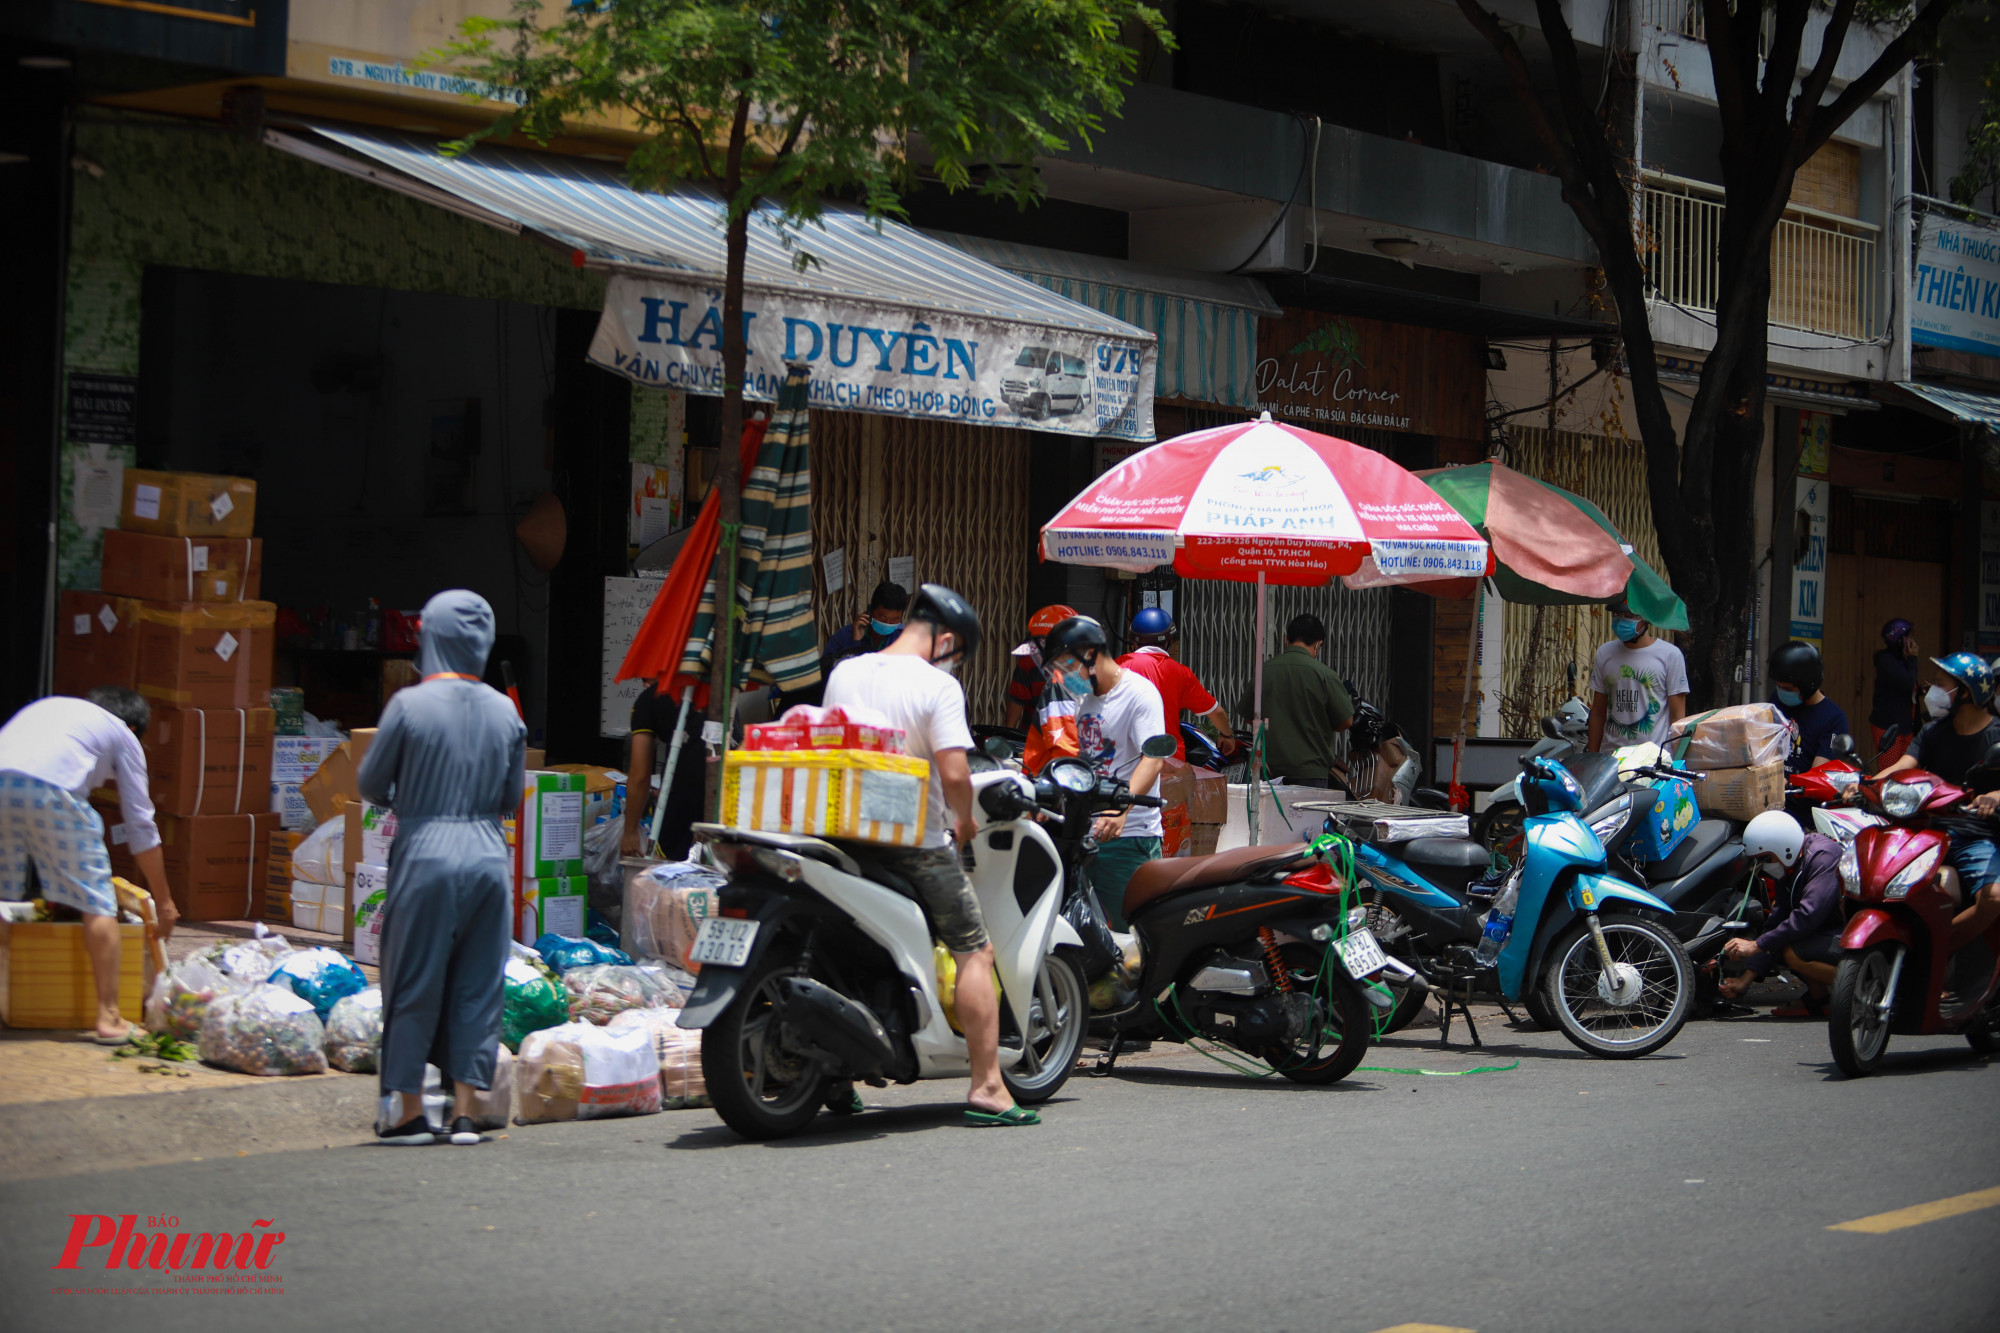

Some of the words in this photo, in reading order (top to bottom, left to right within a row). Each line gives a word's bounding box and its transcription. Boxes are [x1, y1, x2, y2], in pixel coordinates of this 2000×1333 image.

[413, 73, 435, 89] DUY
[1937, 229, 1960, 253] NHÀ
[1961, 237, 1997, 263] THUỐC
[1917, 264, 1980, 314] THIÊN
[780, 316, 979, 382] DUYÊN
[1096, 344, 1141, 375] 97B
[1255, 357, 1327, 396] Dalat
[1332, 368, 1401, 404] Corner
[866, 384, 905, 409] THEO
[949, 388, 997, 418] ĐỒNG
[1206, 511, 1275, 528] PHÁP
[1281, 515, 1335, 530] ANH
[1197, 537, 1250, 546] 222-224-226
[1286, 538, 1304, 548] Duy
[1058, 545, 1104, 558] HOTLINE:
[1106, 546, 1167, 559] 0906.843.118
[1238, 547, 1261, 557] Quận
[1262, 548, 1276, 558] 10,
[1277, 548, 1311, 557] TP.HCM
[1247, 558, 1263, 566] sau
[1264, 558, 1286, 567] TTYK
[1288, 559, 1305, 568] Hòa
[1306, 558, 1328, 570] Hảo)
[1380, 556, 1421, 568] HOTLINE:
[1423, 557, 1482, 571] 0906.843.118
[1799, 579, 1818, 617] KIM
[1616, 689, 1639, 703] HELLO
[1616, 702, 1638, 713] SUMMER
[298, 751, 321, 764] Gold
[1347, 948, 1384, 975] 695.01
